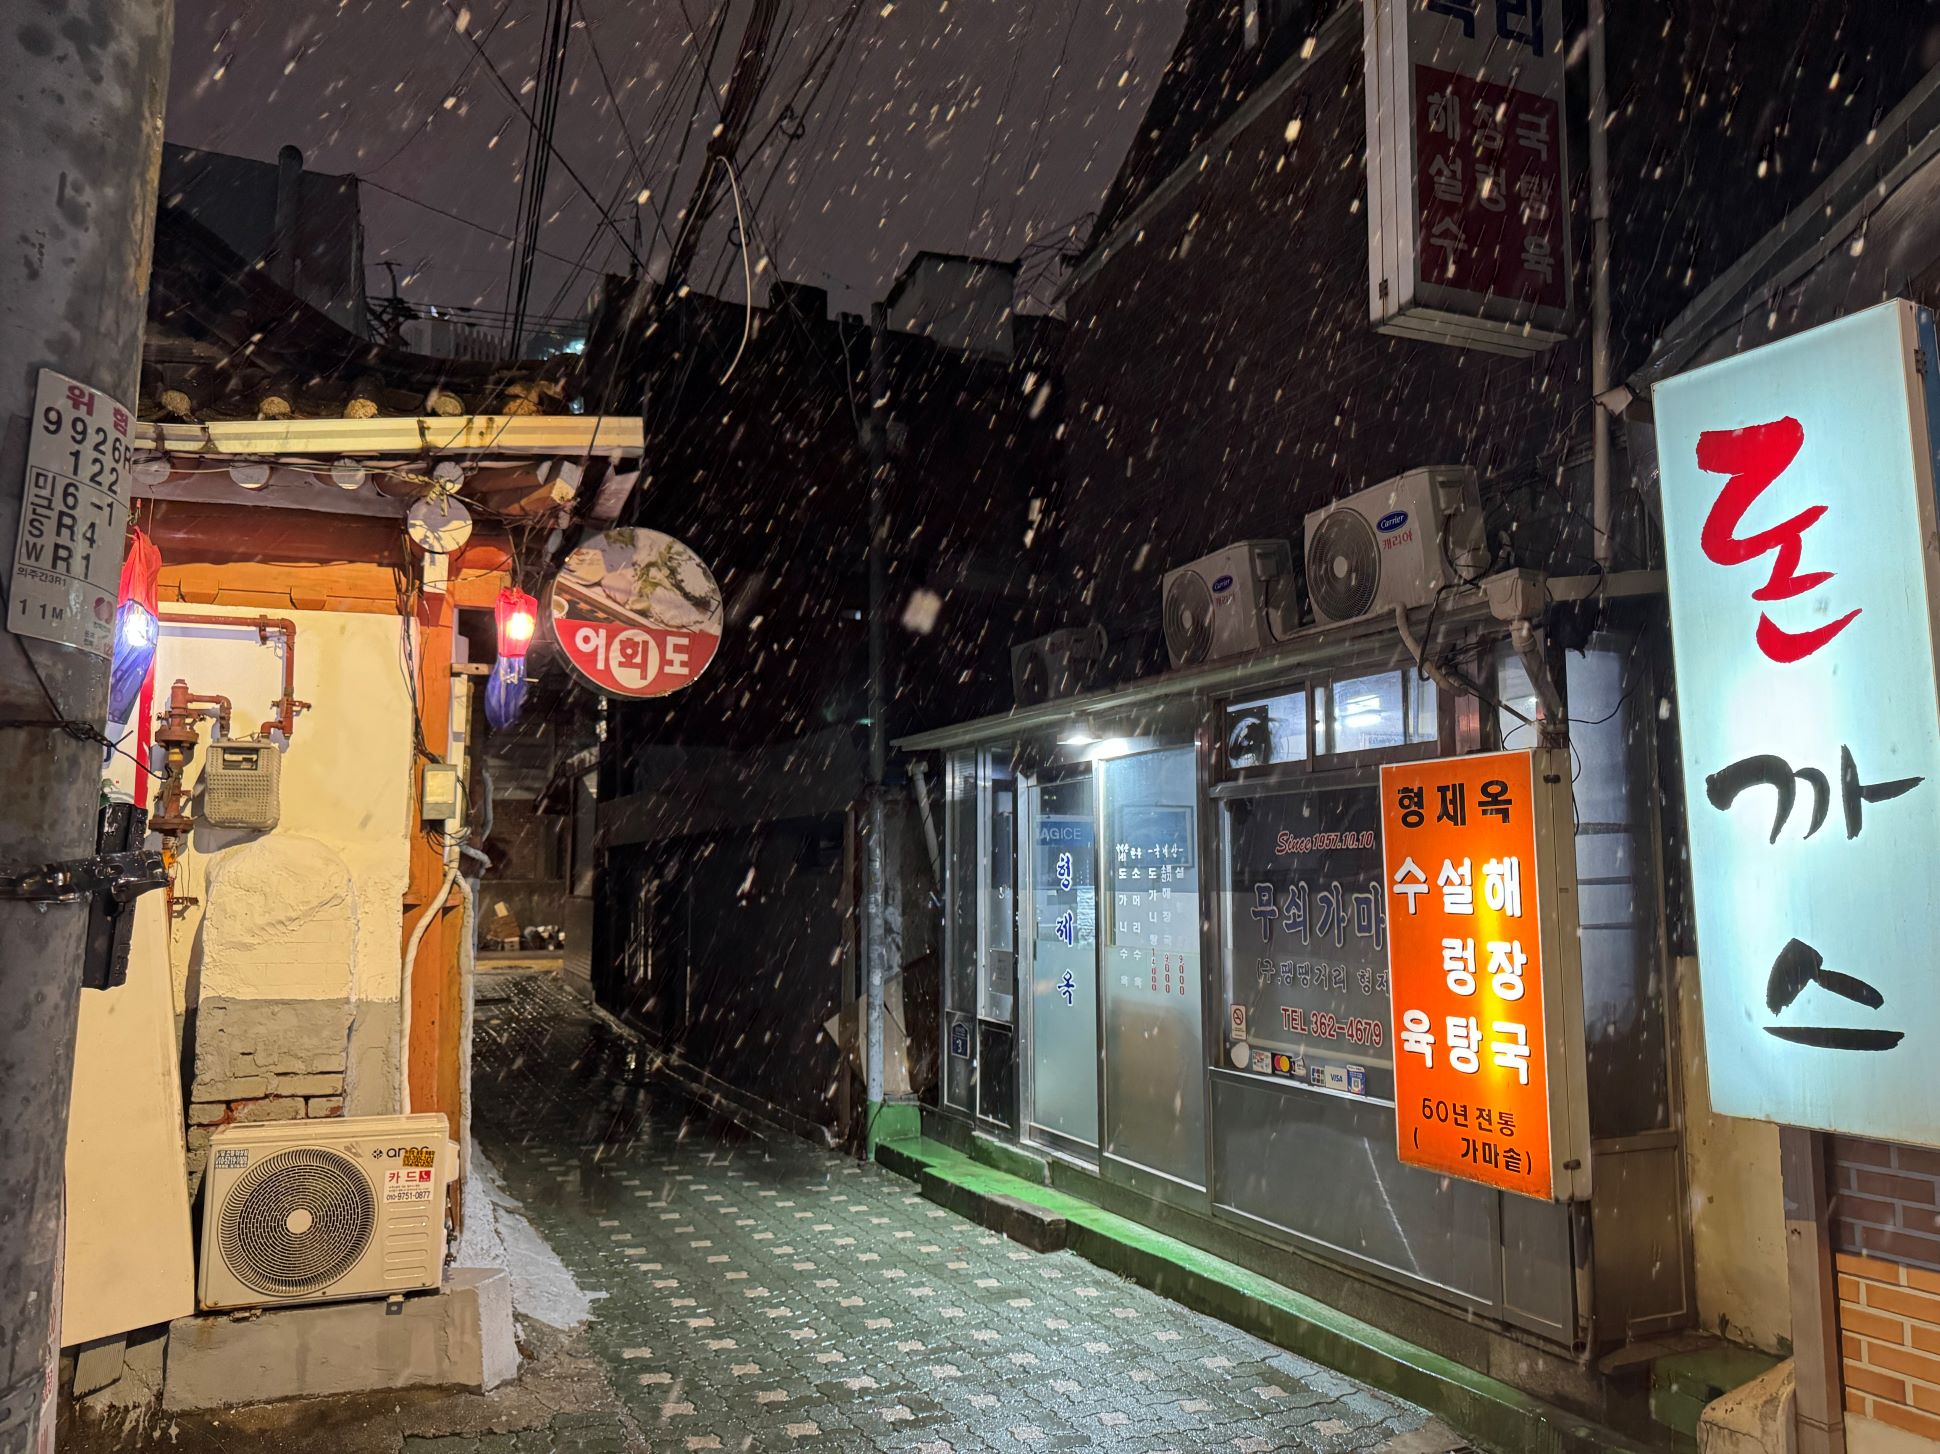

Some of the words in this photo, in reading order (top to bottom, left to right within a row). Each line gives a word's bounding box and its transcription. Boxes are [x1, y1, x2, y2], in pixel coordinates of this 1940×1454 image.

[66, 385, 128, 437] 위험
[69, 449, 119, 496] 122
[1380, 514, 1405, 529] Carrier
[575, 626, 690, 680] 어회도
[1696, 416, 1925, 1052] 돈까스
[1398, 779, 1513, 829] 형제옥
[1275, 831, 1312, 855] Since
[1312, 831, 1375, 850] 1957.10.10
[1056, 852, 1075, 1006] 형제옥
[1280, 1006, 1308, 1034] TEL
[1310, 1010, 1383, 1048] 362-4679
[1330, 1073, 1343, 1083] VISA
[388, 1171, 417, 1184] 카드
